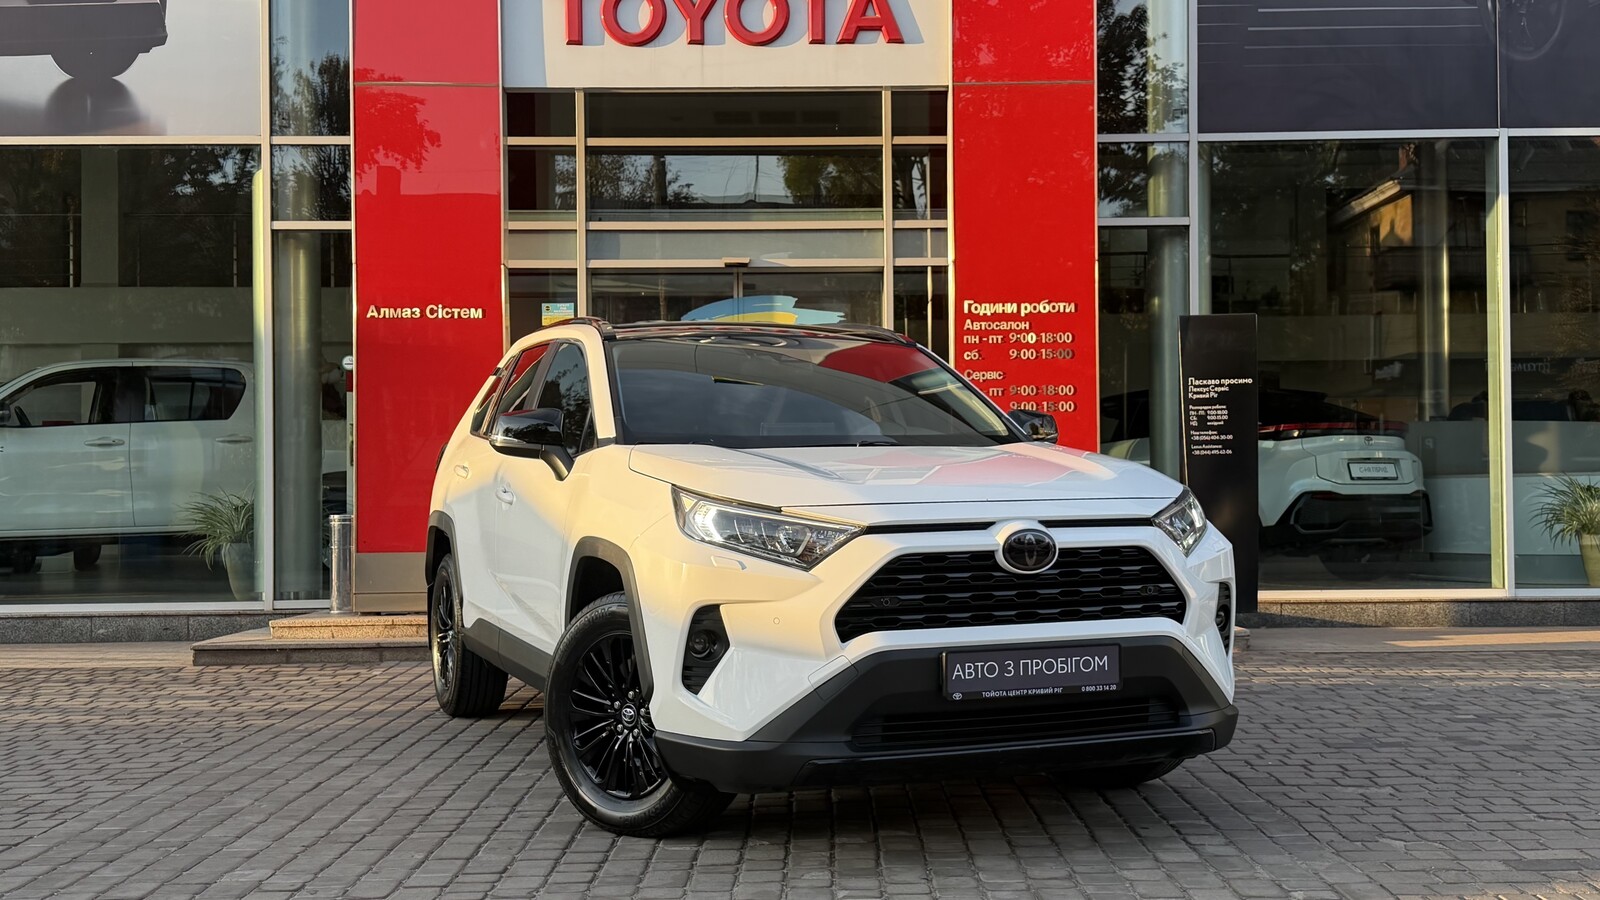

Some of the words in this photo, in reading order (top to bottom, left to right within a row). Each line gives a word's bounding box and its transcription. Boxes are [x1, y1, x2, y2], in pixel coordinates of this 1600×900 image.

[366, 304, 420, 318] Алмаз
[425, 304, 483, 319] Сістем
[964, 300, 1017, 316] Години
[1020, 300, 1076, 317] роботи
[964, 319, 1030, 330] Автосалон
[963, 335, 979, 344] пн
[964, 369, 1004, 382] Сервіс
[1188, 377, 1220, 386] Ласкаво
[952, 661, 999, 680] АВТО
[1004, 660, 1015, 677] З
[1020, 655, 1108, 676] ПРОБІГОМ
[982, 690, 1007, 698] ТОЙОТА
[1008, 689, 1027, 697] ЦЕНТР
[1028, 687, 1053, 695] КРИВИЙ
